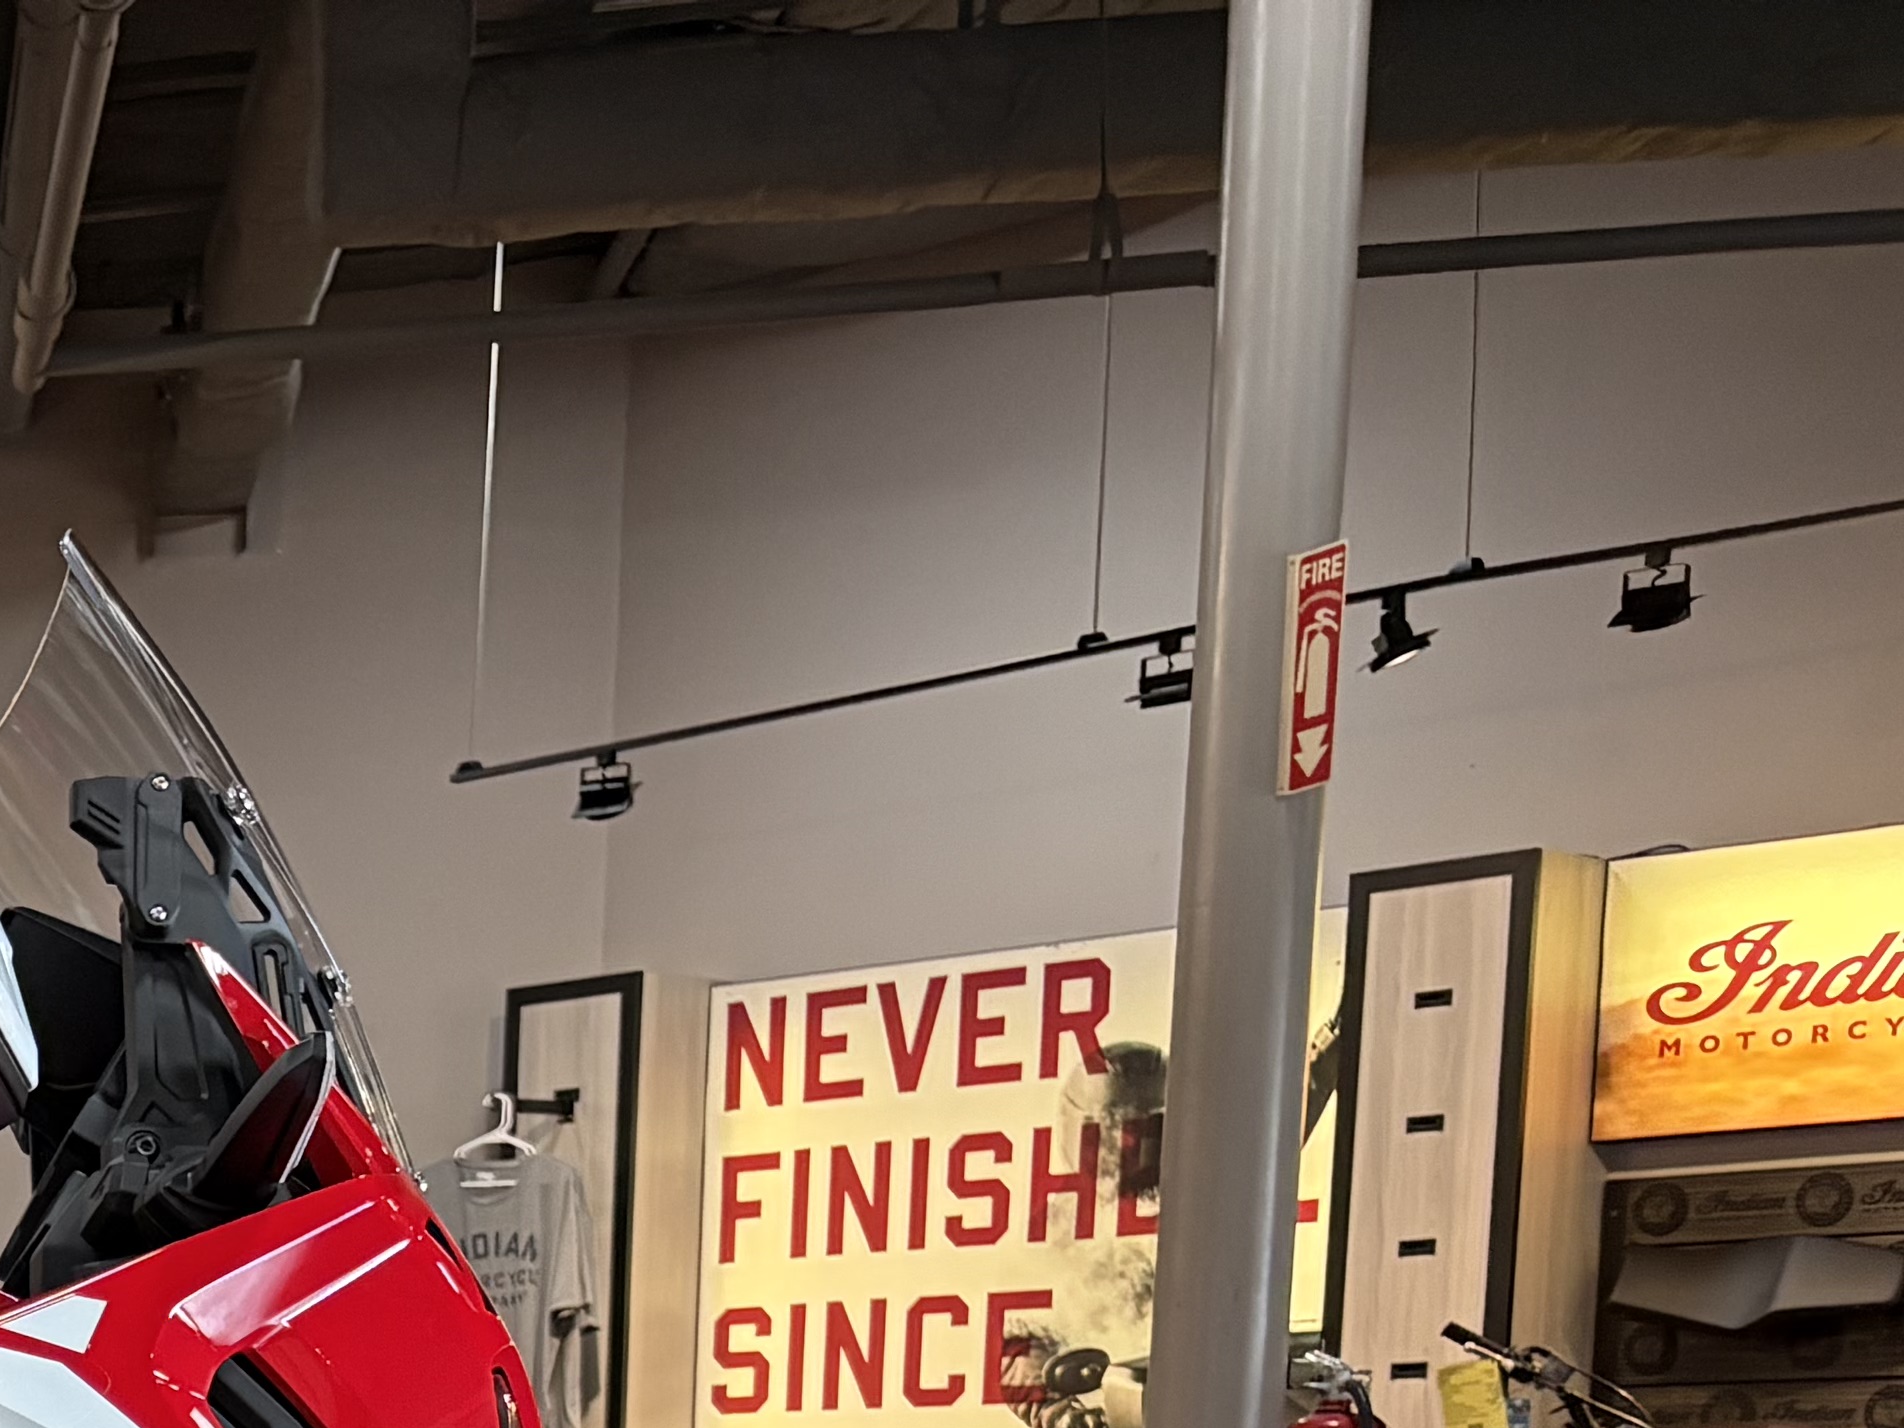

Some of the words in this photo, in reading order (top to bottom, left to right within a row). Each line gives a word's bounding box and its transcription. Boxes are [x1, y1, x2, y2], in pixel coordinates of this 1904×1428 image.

[1300, 553, 1344, 590] FIRE
[723, 956, 1111, 1113] NEVER
[711, 1289, 1053, 1415] SINCE
